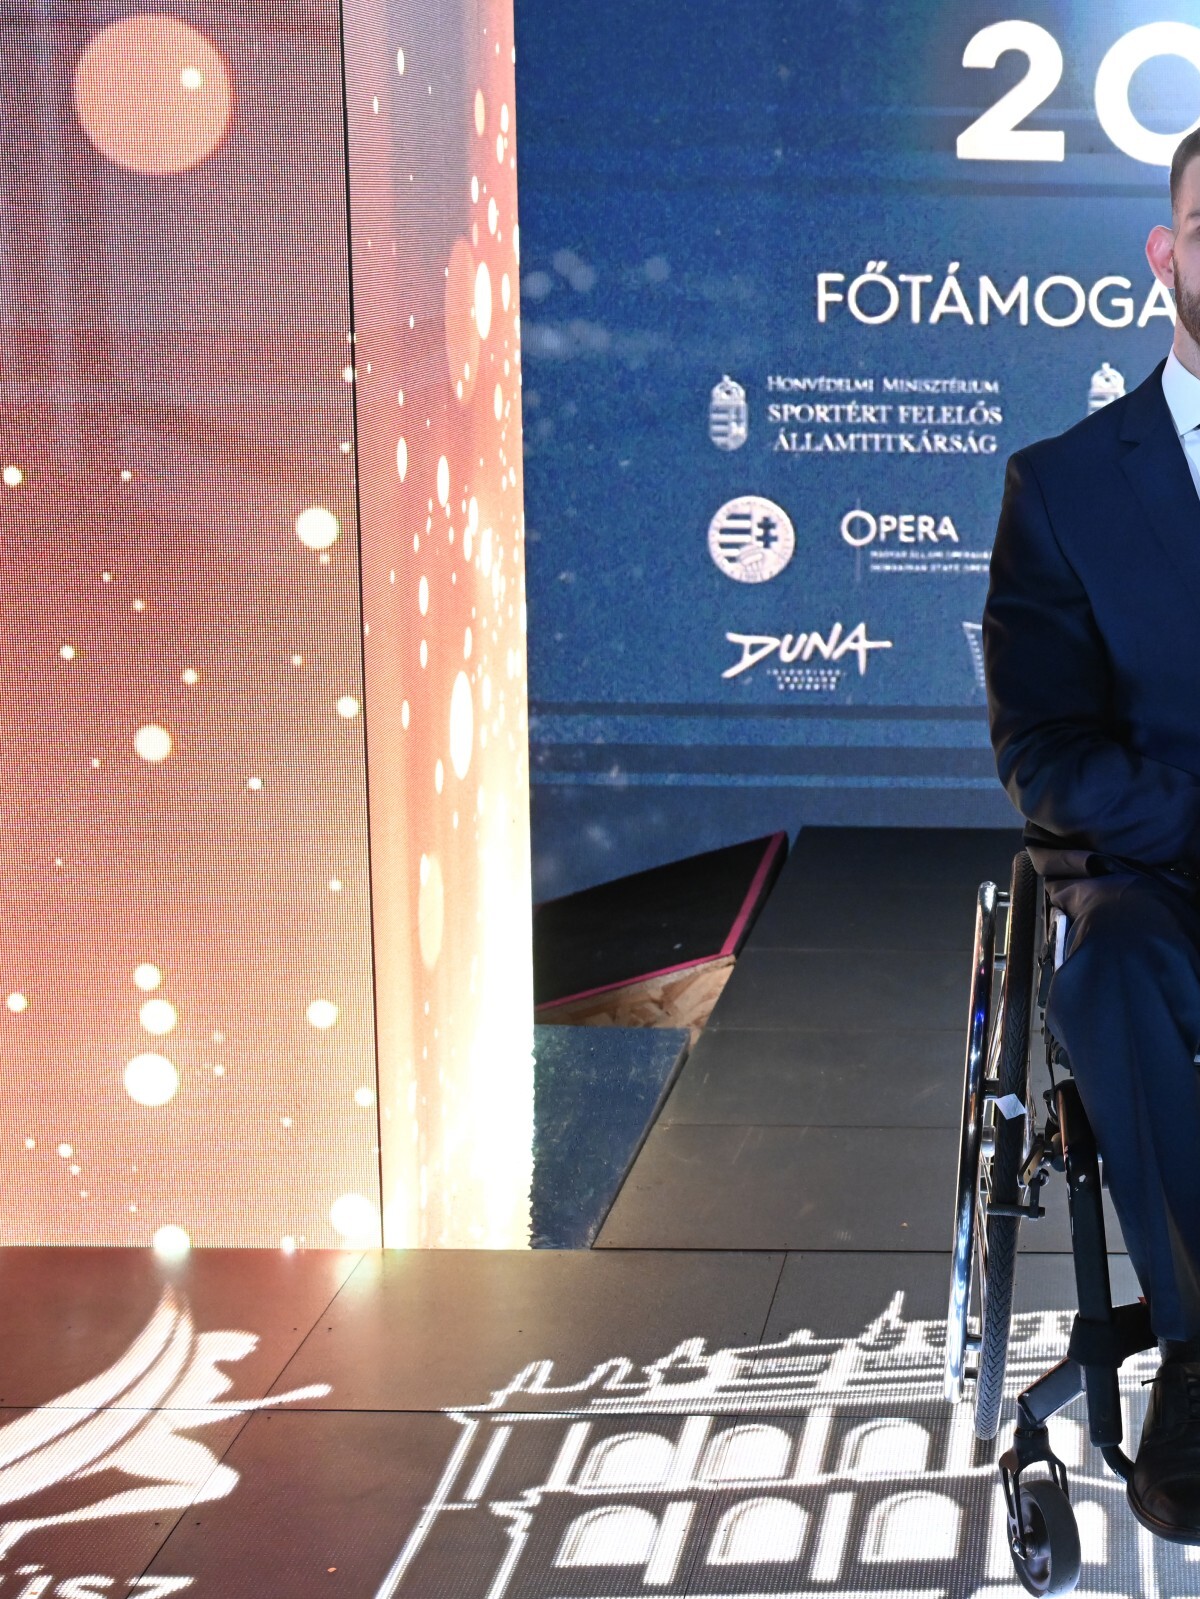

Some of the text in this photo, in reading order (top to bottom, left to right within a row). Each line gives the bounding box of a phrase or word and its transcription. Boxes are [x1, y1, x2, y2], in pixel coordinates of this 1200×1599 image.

[815, 261, 1176, 328] FŐTÁMOGA
[767, 400, 1003, 425] SPORTÉRT FELELŐS
[840, 510, 959, 546] OPERA
[721, 622, 892, 678] DUNA
